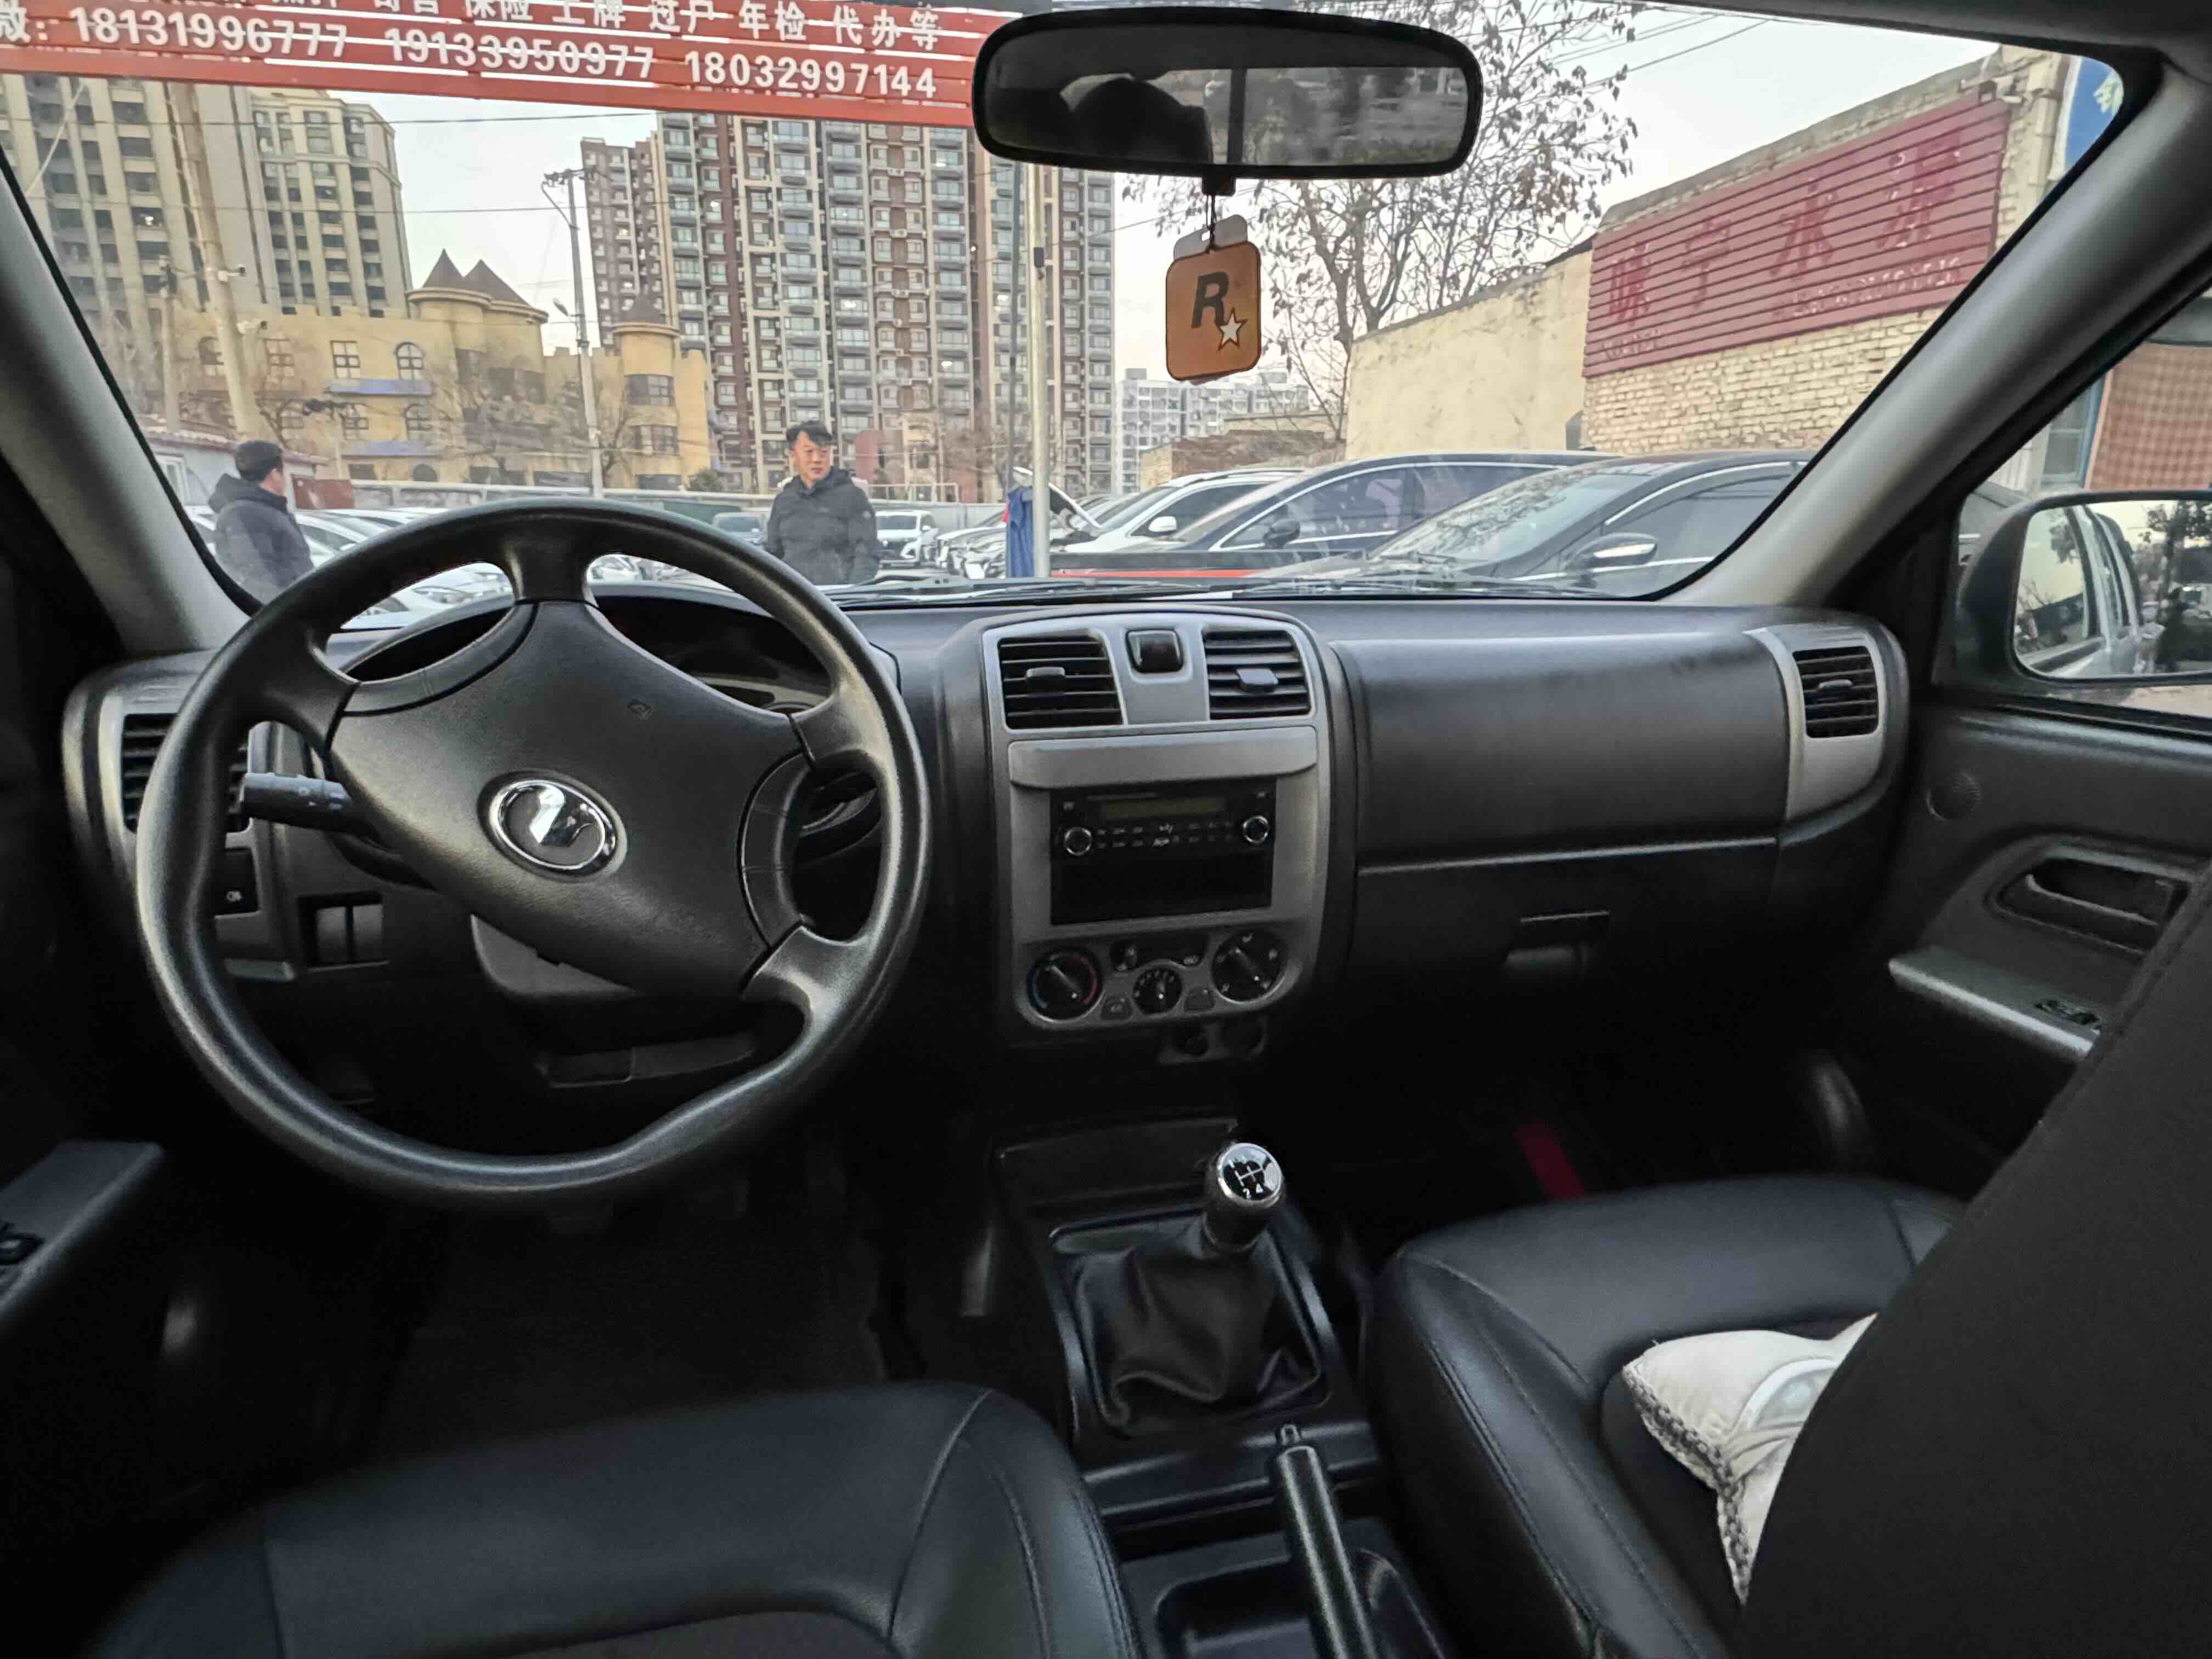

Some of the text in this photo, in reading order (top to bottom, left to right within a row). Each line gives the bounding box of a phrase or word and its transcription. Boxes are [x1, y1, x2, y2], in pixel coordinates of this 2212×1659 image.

[70, 7, 347, 58] 18131996777
[385, 27, 654, 78] 19133950977
[685, 50, 936, 98] 18032997144
[648, 0, 714, 33] 过户
[738, 0, 807, 42] 年检
[832, 2, 939, 51] 代办等
[1191, 271, 1229, 329] R
